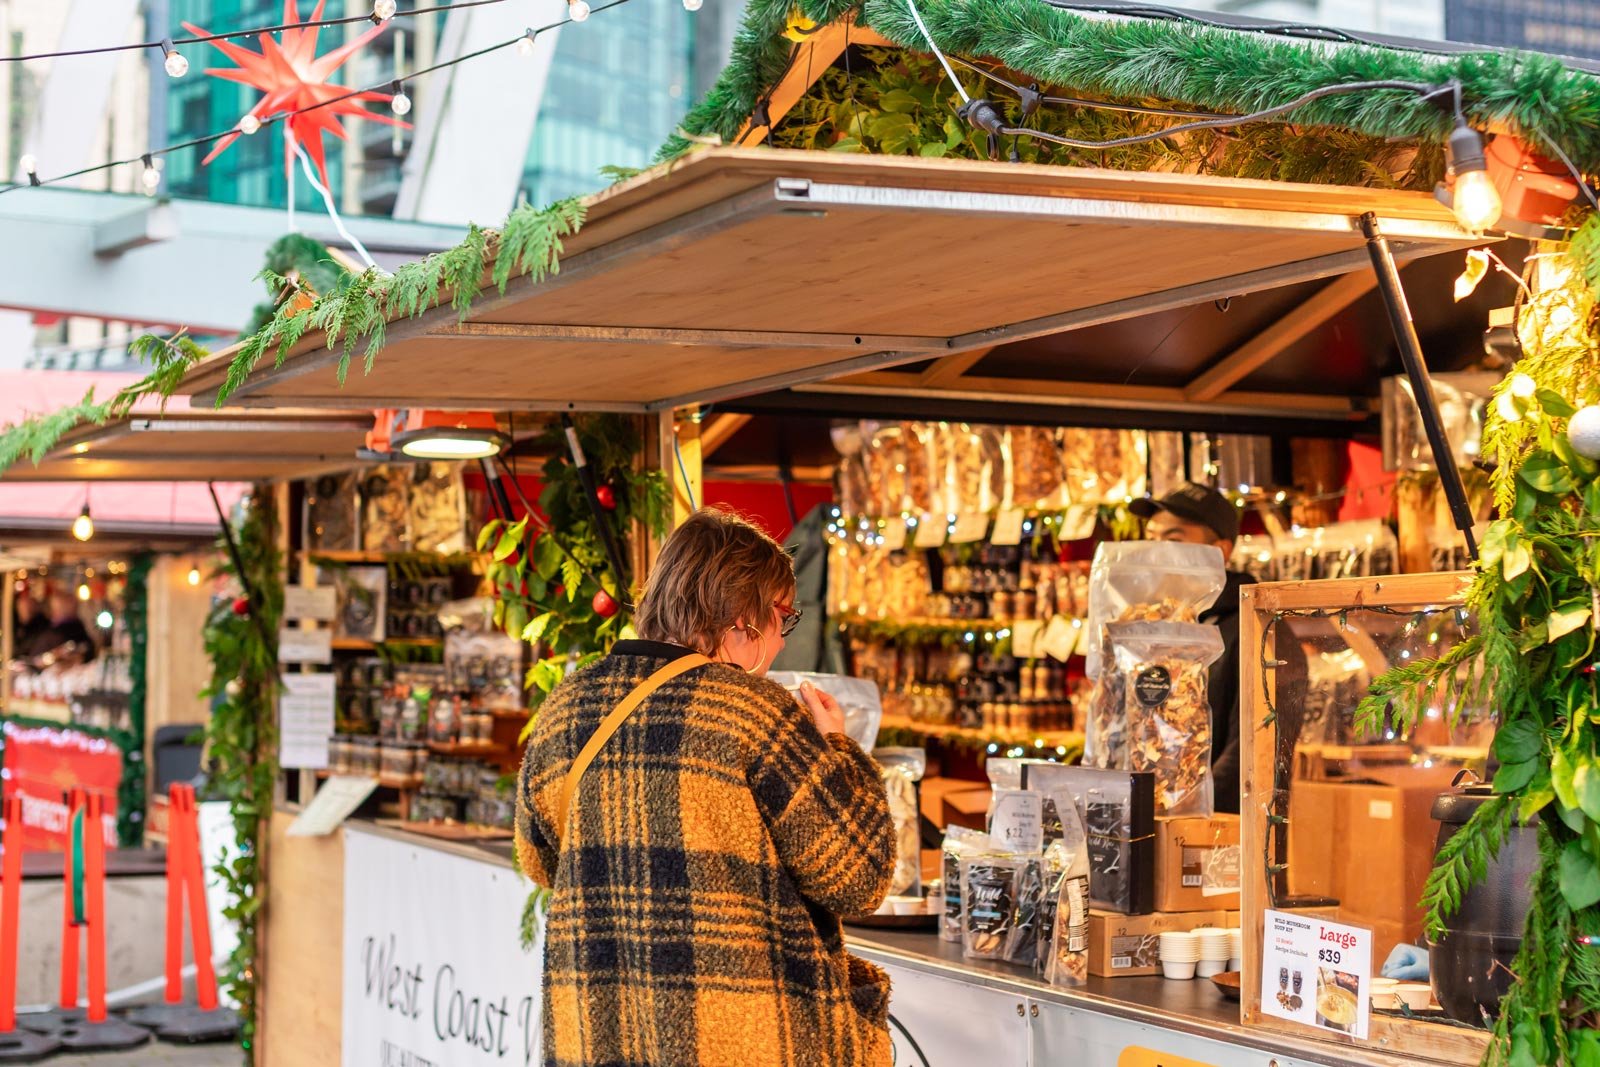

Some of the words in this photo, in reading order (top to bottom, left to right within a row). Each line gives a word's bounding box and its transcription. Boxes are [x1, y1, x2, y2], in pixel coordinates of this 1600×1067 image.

[1174, 836, 1185, 847] 12
[1117, 927, 1127, 936] 12
[1286, 920, 1310, 930] MUSHROOM
[1320, 926, 1356, 949] Large
[1318, 948, 1341, 964] $39
[362, 933, 423, 1020] West
[433, 963, 509, 1058] Coast
